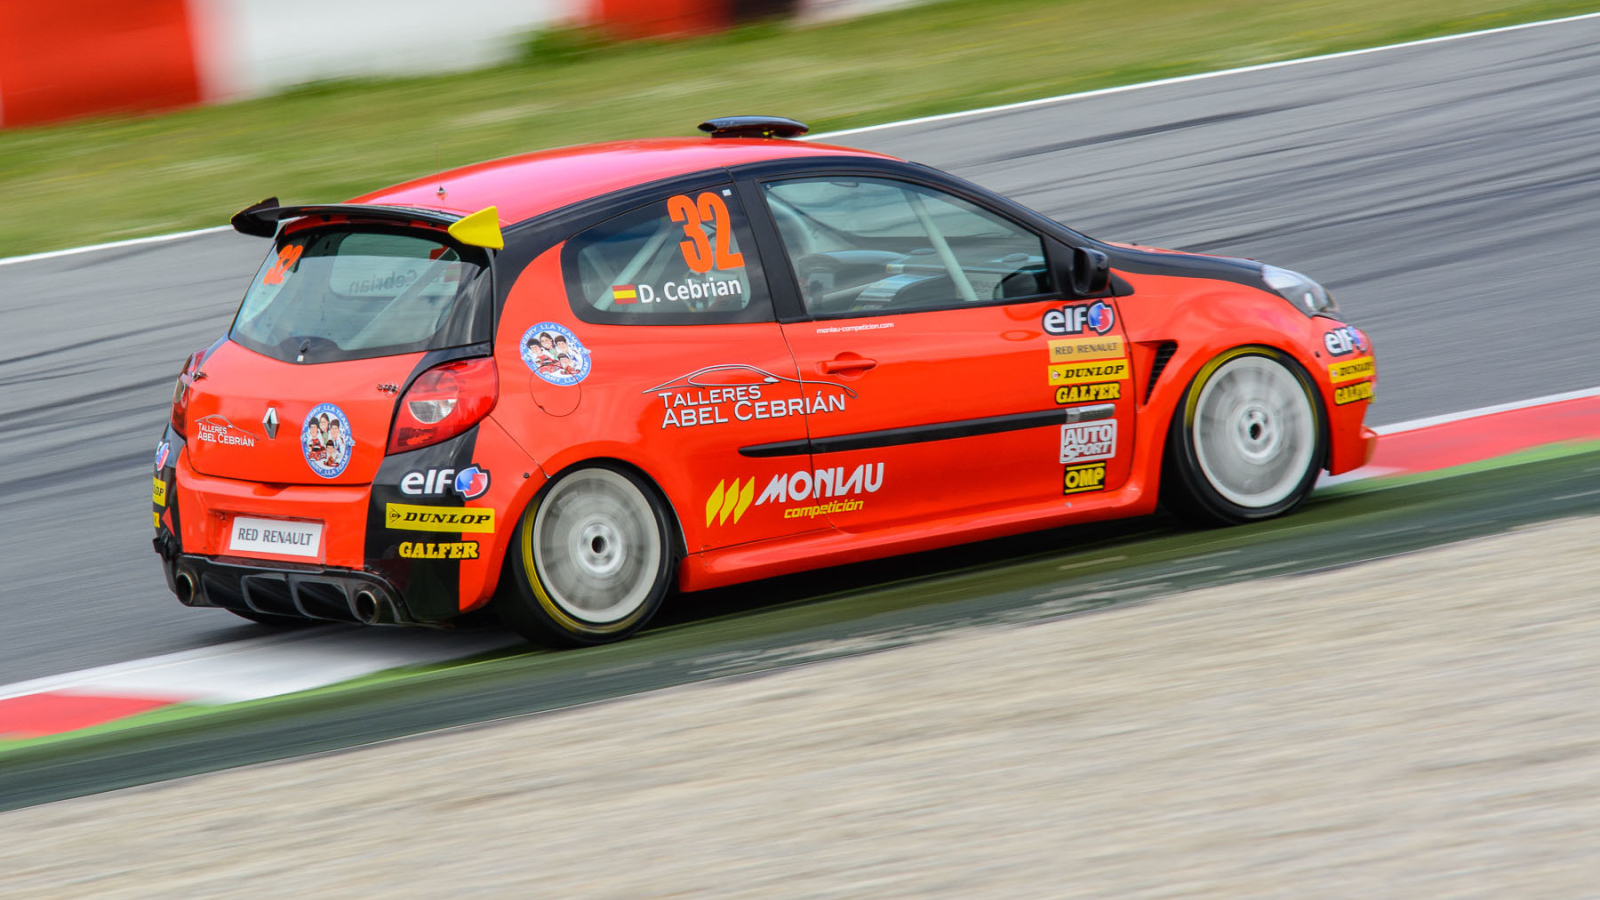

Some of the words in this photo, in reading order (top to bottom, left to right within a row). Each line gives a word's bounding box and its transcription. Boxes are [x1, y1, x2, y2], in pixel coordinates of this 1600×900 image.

[667, 192, 745, 273] 32
[263, 245, 303, 285] 32
[638, 284, 661, 303] D.
[663, 277, 742, 301] Cebrian
[1043, 307, 1088, 333] elf
[1055, 345, 1074, 355] RED
[1077, 342, 1118, 353] RENAULT
[1325, 328, 1354, 354] elf
[1064, 364, 1125, 379] DUNLOP
[658, 386, 761, 409] TALLERES
[1055, 382, 1120, 404] GALFER
[661, 407, 729, 429] ABEL
[734, 391, 846, 421] CEBRIÁN
[198, 423, 227, 435] TALLERES
[198, 431, 217, 442] ABEL
[217, 433, 255, 447] CEBRIÁN
[1064, 425, 1113, 446] AUTO
[1062, 441, 1112, 462] SPORT
[401, 469, 455, 495] elf
[755, 462, 885, 506] MONLAU
[1065, 467, 1105, 488] OMP
[404, 512, 491, 524] DUNLOP
[784, 499, 864, 519] competición
[238, 528, 259, 541] RED
[262, 529, 313, 546] RENAULT
[399, 542, 479, 559] GALFER
